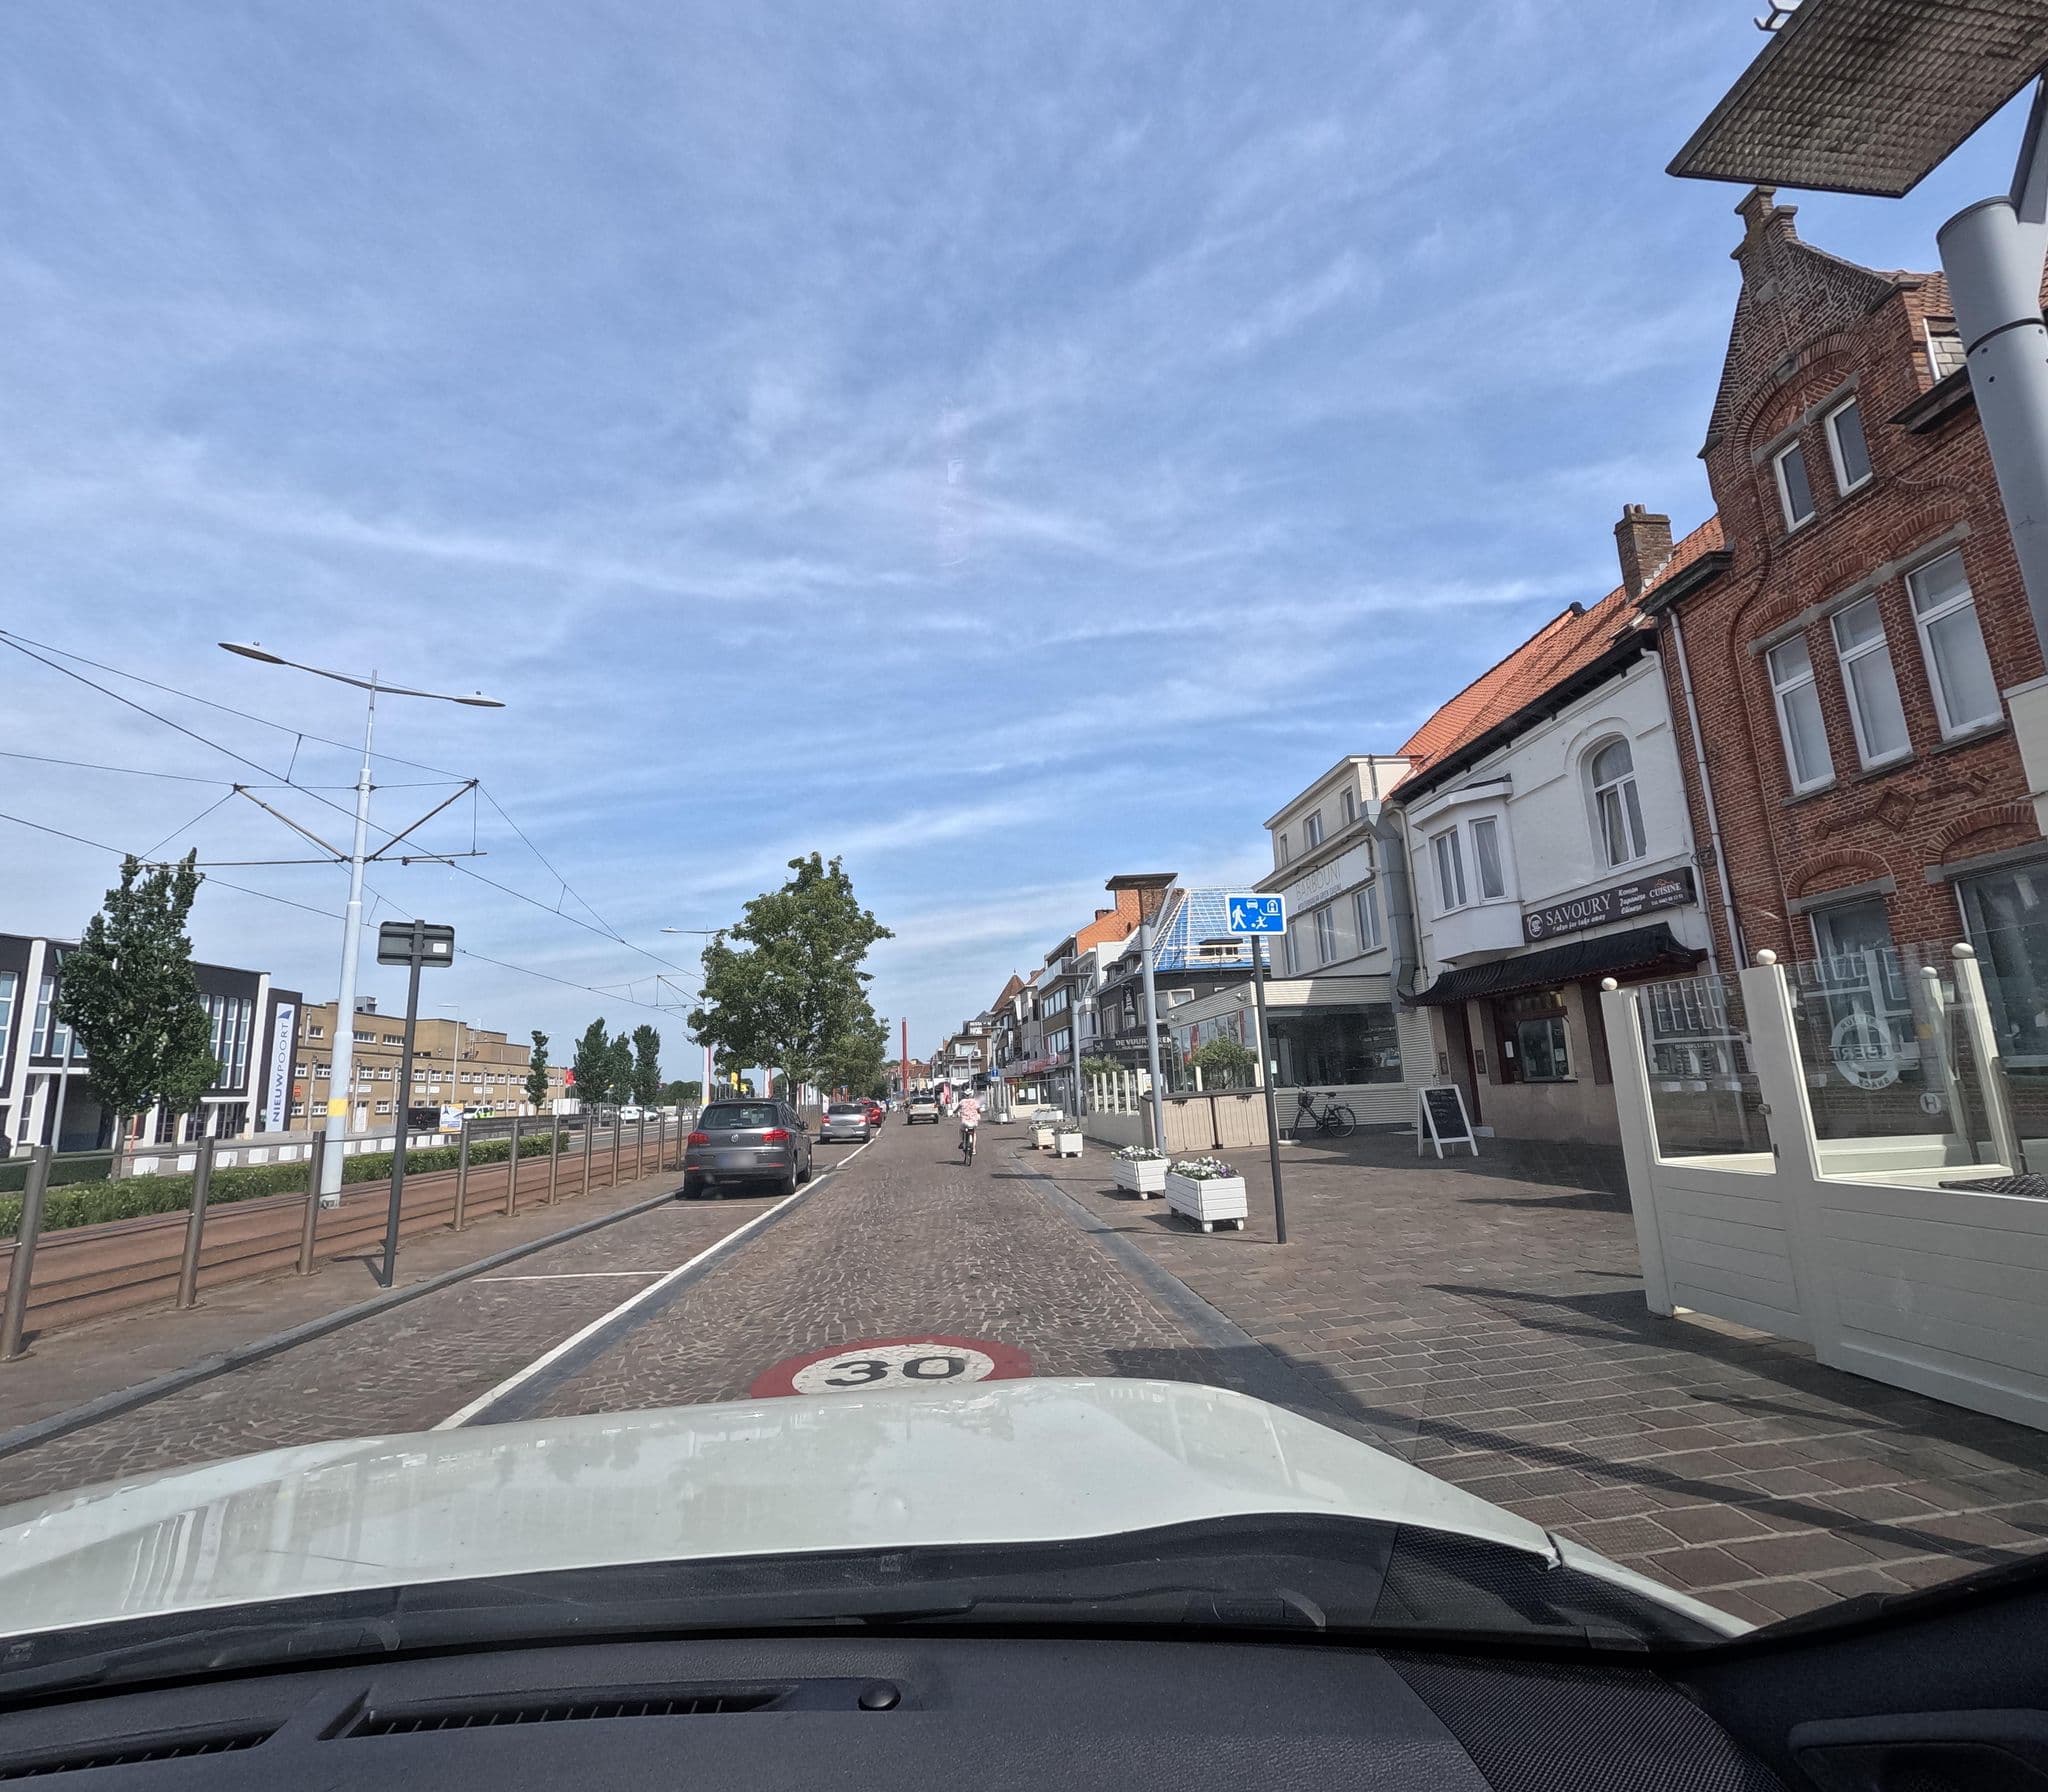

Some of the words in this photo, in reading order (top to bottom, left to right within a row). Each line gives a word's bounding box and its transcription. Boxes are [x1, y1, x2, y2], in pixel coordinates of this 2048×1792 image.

[1649, 882, 1682, 898] CUISINE
[1546, 894, 1611, 926] SAVOURY
[272, 1022, 289, 1123] NIEUWPOORT
[824, 1356, 966, 1387] 30
